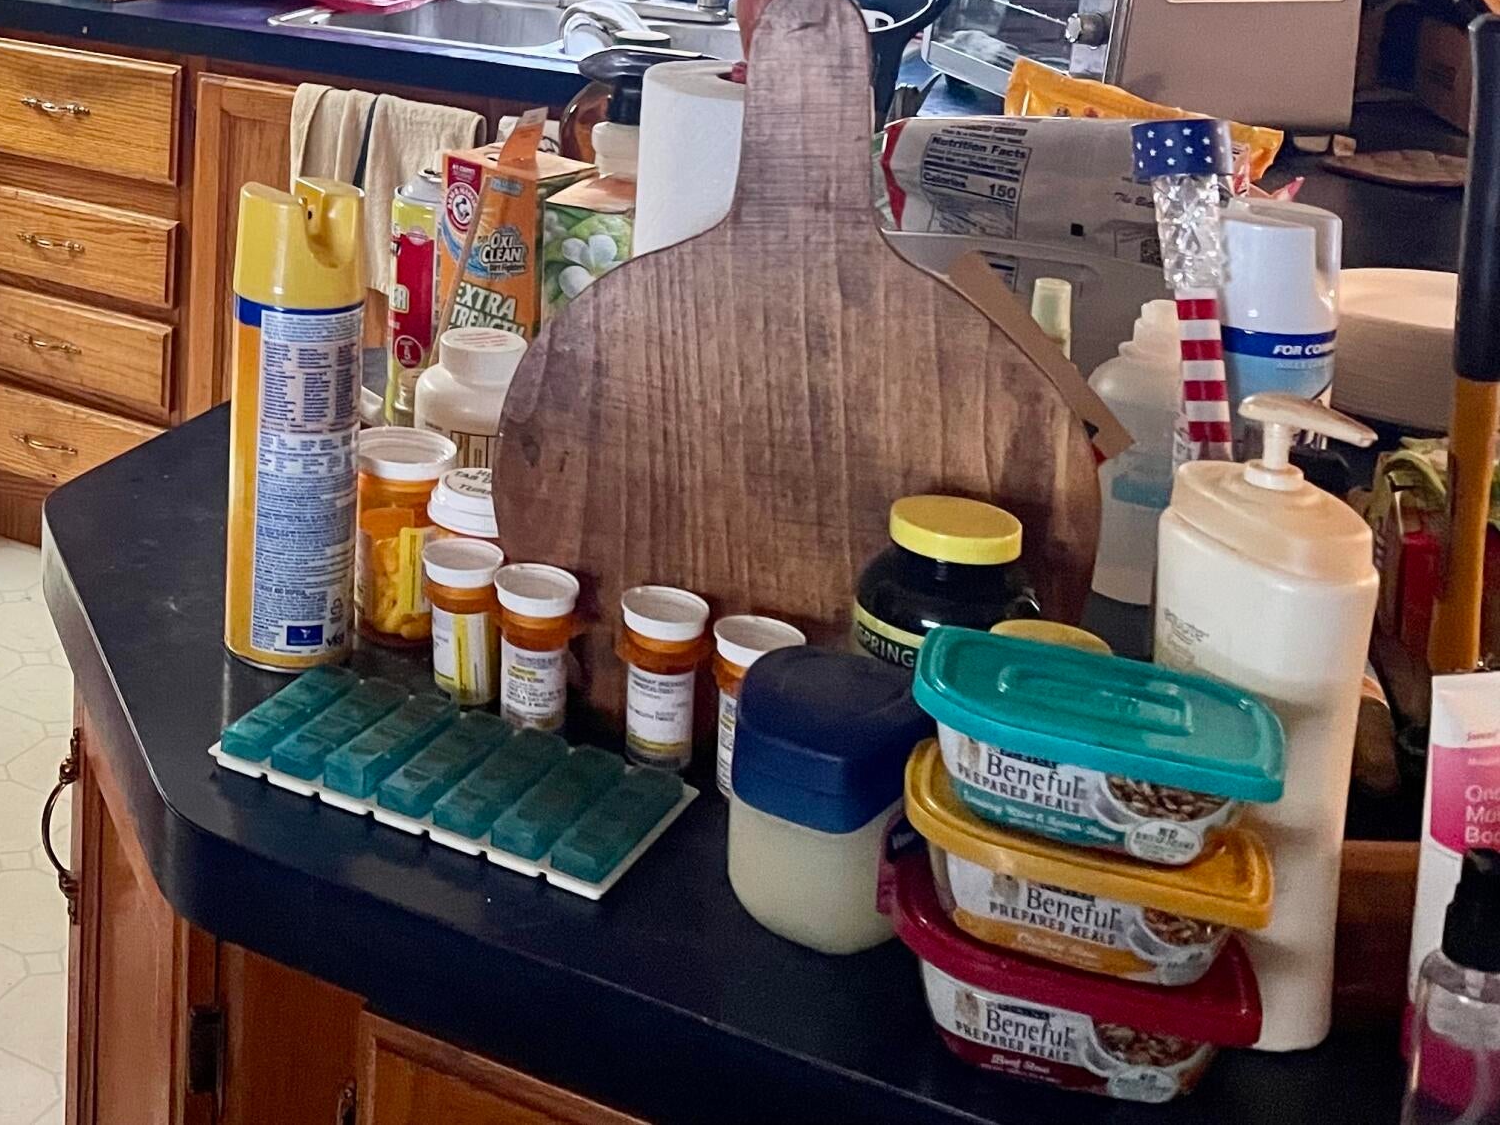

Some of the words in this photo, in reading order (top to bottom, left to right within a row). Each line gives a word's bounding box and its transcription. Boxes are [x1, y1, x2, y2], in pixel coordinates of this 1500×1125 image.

[931, 136, 987, 153] Nutrition
[991, 145, 1027, 159] Facts
[989, 184, 1017, 199] 150
[479, 244, 523, 266] CLEAN
[490, 232, 515, 251] OXI
[456, 282, 517, 321] EXTRA
[1272, 344, 1303, 356] FOR
[957, 762, 1028, 801] PREPARED
[1033, 792, 1081, 814] MEALS
[986, 753, 1082, 800] Beneful
[989, 901, 1066, 933] PREPARED
[1070, 925, 1117, 946] MEALS
[1027, 887, 1122, 930] Beneful
[955, 1020, 1025, 1052] PREPARED
[1029, 1042, 1071, 1063] MEALS
[986, 1008, 1077, 1049] Beneful
